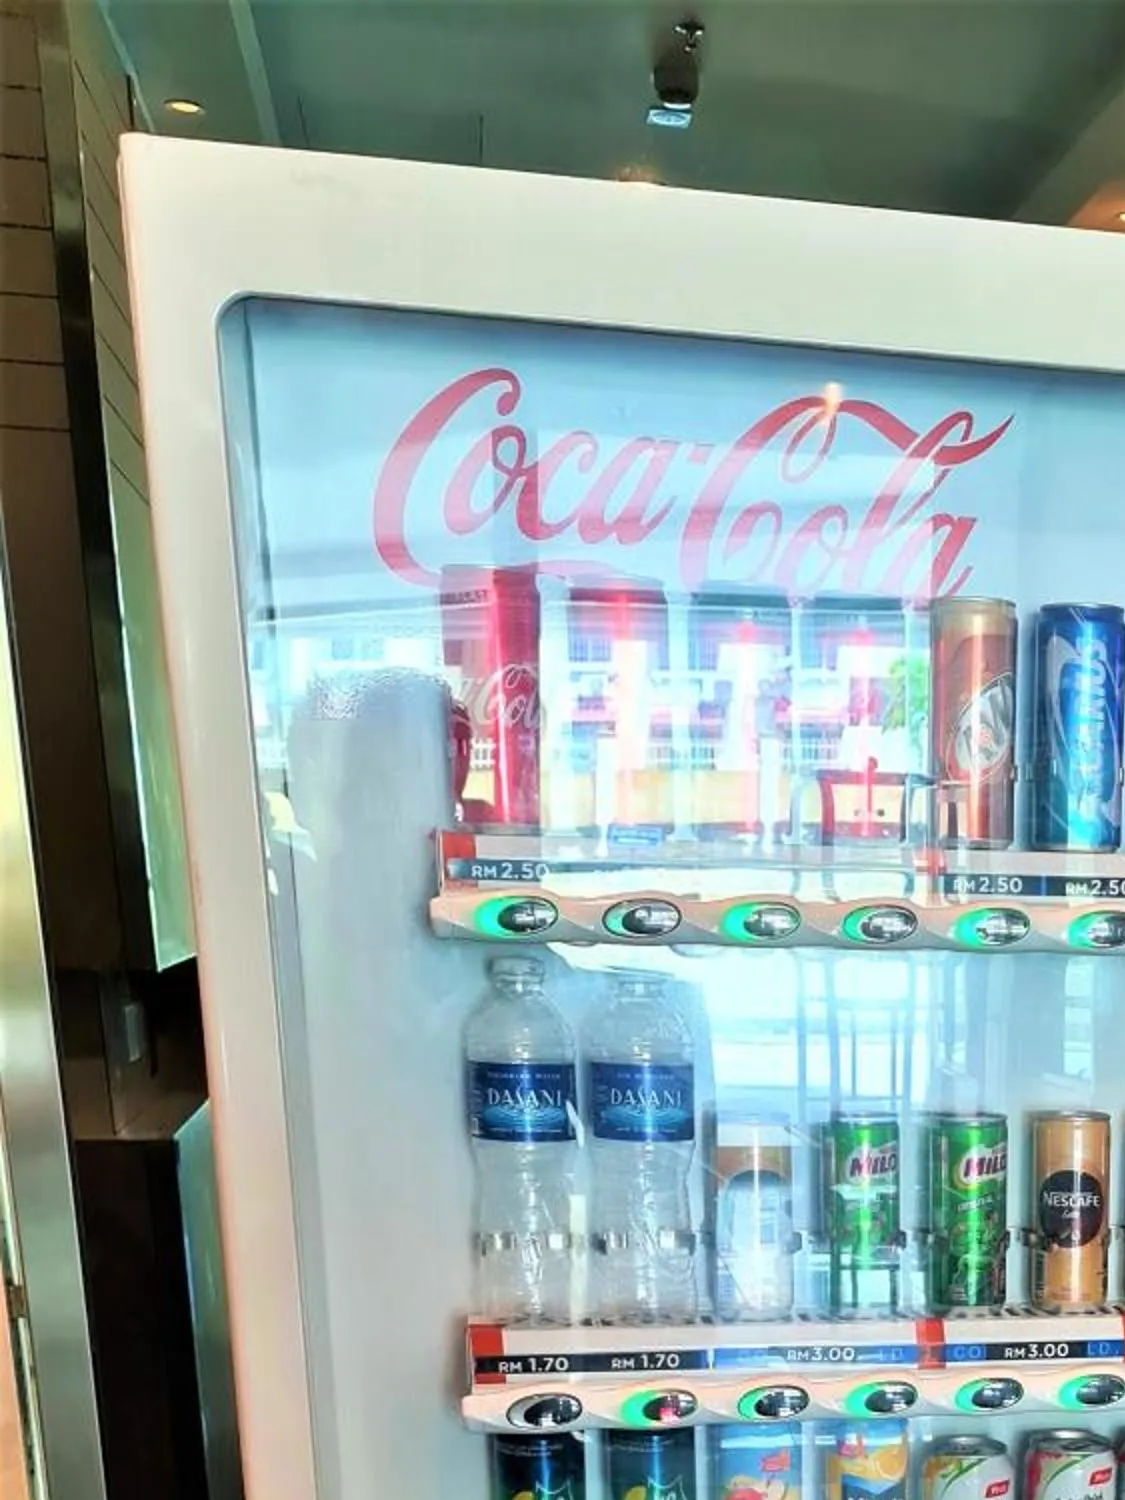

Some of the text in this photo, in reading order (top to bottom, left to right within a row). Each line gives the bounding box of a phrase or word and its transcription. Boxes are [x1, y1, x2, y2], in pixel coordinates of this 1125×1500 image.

[501, 862, 548, 880] 2.50
[979, 877, 1023, 894] 2.50
[488, 1084, 562, 1107] DASANI
[611, 1085, 682, 1107] DASANI
[811, 1346, 857, 1361] 3.00
[1028, 1343, 1070, 1359] 3.00
[528, 1356, 569, 1373] 1.70
[641, 1352, 680, 1370] 1.70
